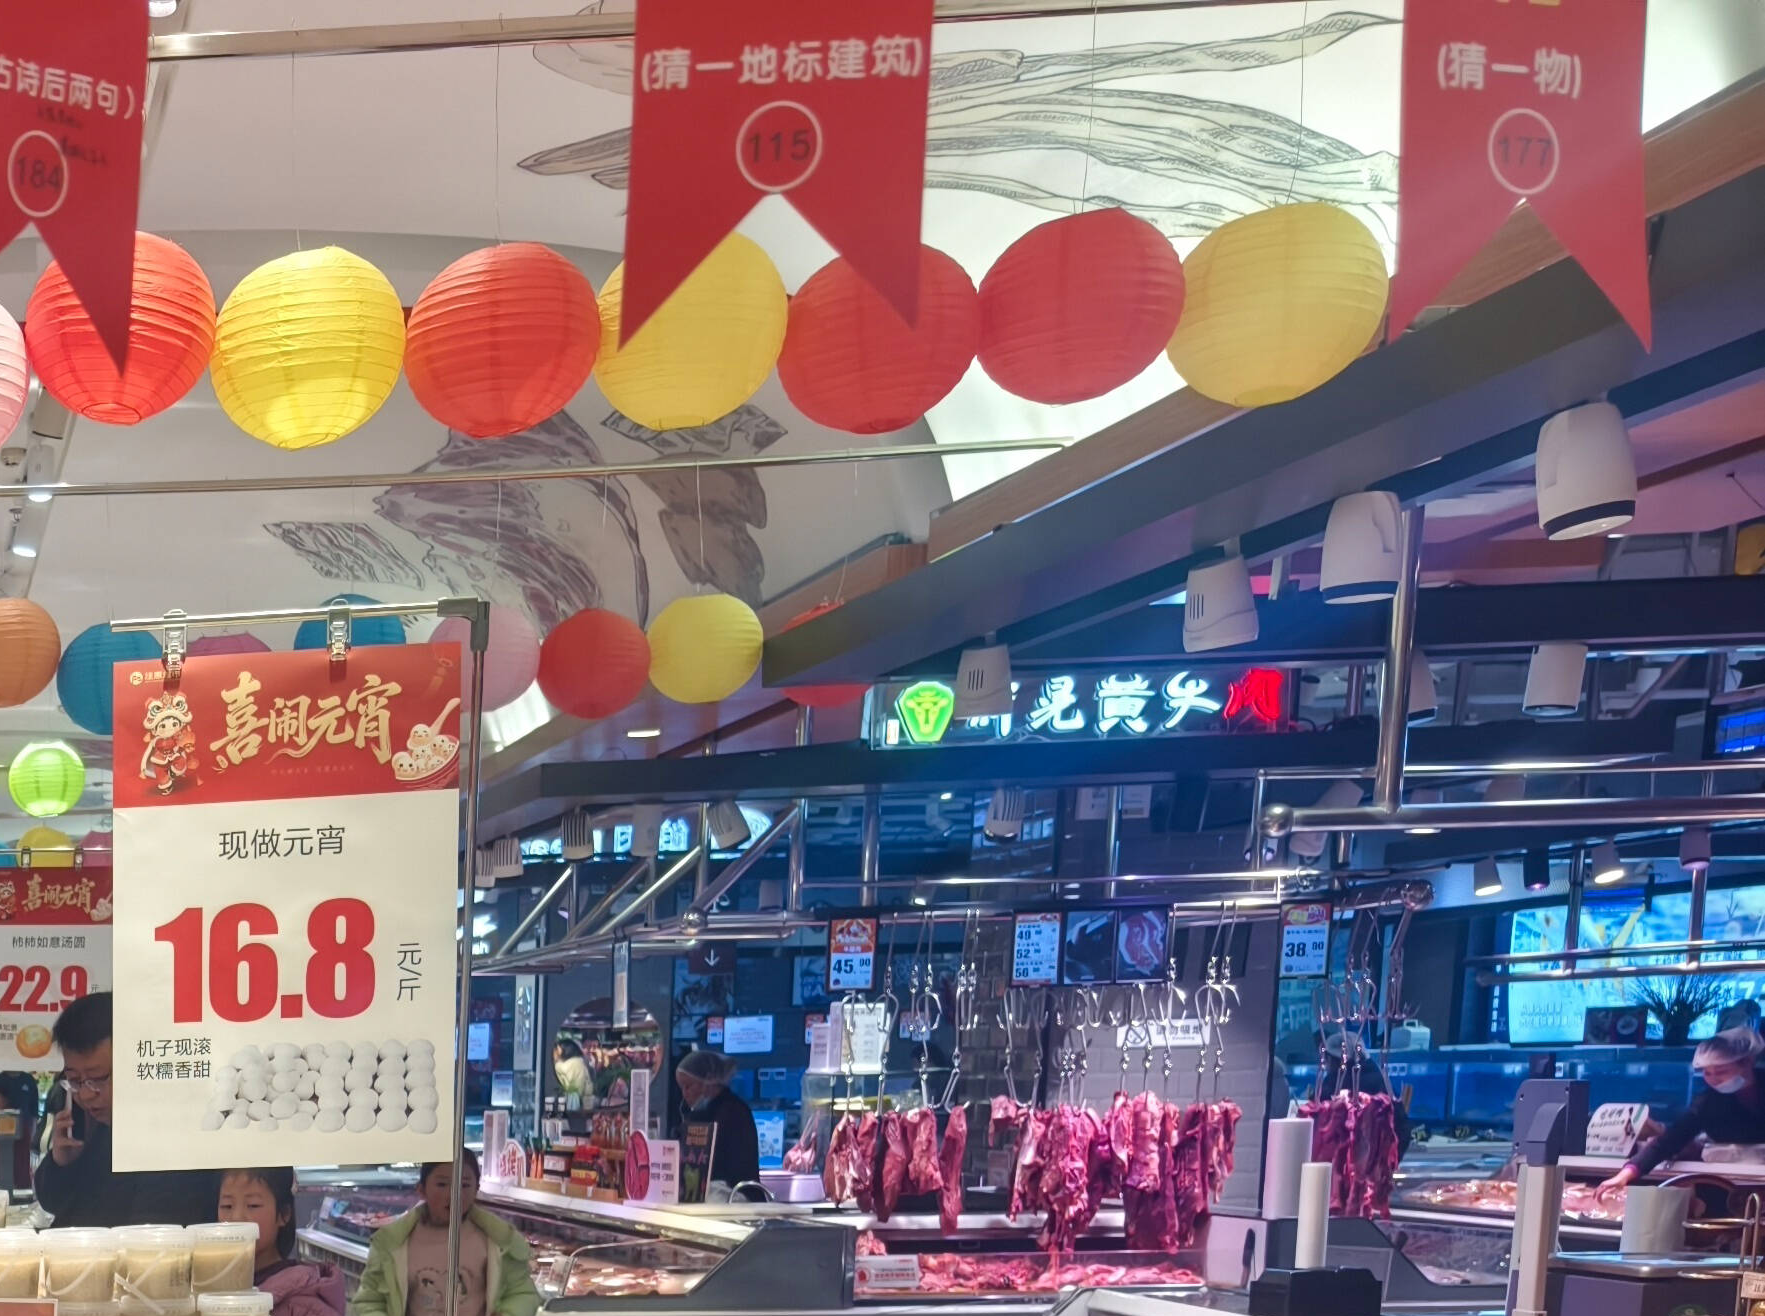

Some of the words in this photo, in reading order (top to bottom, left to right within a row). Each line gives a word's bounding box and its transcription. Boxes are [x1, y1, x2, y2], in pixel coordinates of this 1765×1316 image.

[1437, 43, 1582, 99] (猜一物)
[749, 129, 811, 163] 115
[1498, 136, 1553, 167] 177
[18, 157, 62, 191] 184
[210, 671, 402, 765] 喜闹元宵
[219, 825, 346, 861] 现做元宵
[21, 873, 96, 914] 喜闹元宵
[155, 898, 376, 1024] 16.8
[136, 1037, 212, 1059] 机子现滚
[136, 1060, 211, 1081] 软糯香甜
